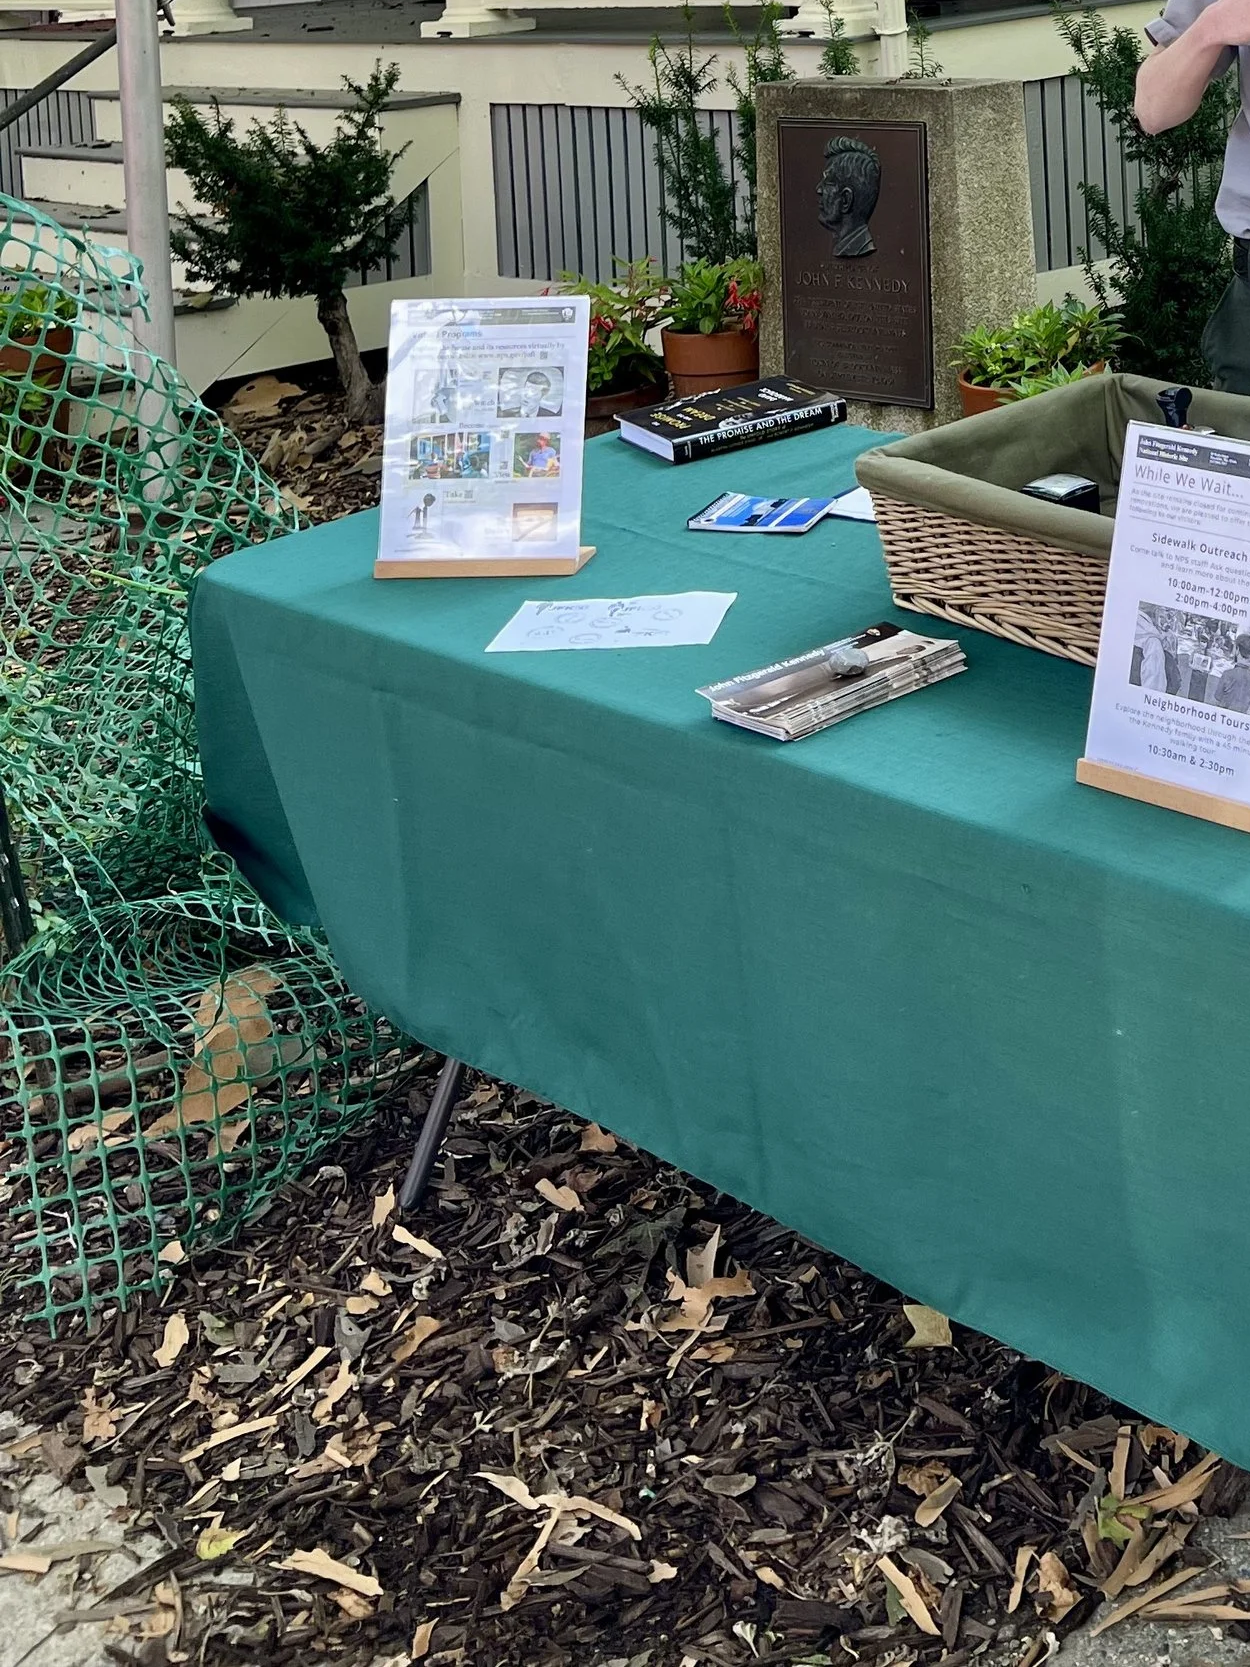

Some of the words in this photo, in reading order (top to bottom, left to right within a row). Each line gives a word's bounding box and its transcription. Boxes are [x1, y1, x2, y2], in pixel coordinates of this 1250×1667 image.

[796, 271, 829, 286] JOHN
[847, 276, 911, 293] KENNEDY
[698, 434, 714, 445] THE
[716, 424, 753, 440] PROMISE
[756, 419, 774, 429] AND
[775, 414, 791, 425] THE
[794, 407, 822, 420] DREAM
[1138, 447, 1158, 456] National
[1139, 438, 1151, 446] John
[1176, 444, 1198, 456] Kennedy
[1134, 463, 1170, 483] While
[1174, 472, 1195, 488] We
[1200, 477, 1244, 498] Wait...
[1193, 500, 1215, 510] closed
[1216, 504, 1226, 512] for
[1193, 509, 1219, 520] pleased
[1130, 544, 1150, 554] Come
[1151, 549, 1164, 558] talk
[1165, 552, 1172, 560] to
[1174, 555, 1189, 563] NPS
[1209, 562, 1223, 571] Ask
[1151, 532, 1196, 550] Sidewalk
[1199, 542, 1248, 562] Outreach
[1166, 576, 1249, 605] 10:00am-12:00pm
[1175, 565, 1193, 574] learn
[1194, 569, 1213, 578] more
[1215, 573, 1235, 583] about
[1237, 579, 1249, 587] the
[1174, 592, 1248, 619] 2:00pm-4:00pm
[710, 679, 733, 692] John
[735, 663, 782, 685] Fitzgerald
[782, 649, 825, 670] Kennedy
[1143, 694, 1217, 724] Neighborhood
[1220, 714, 1250, 731] Tours
[1142, 720, 1173, 735] Kennedy
[1198, 735, 1214, 745] with
[1222, 741, 1232, 750] 45
[1155, 713, 1205, 734] neighborhood
[1207, 727, 1237, 743] through
[1147, 743, 1187, 762] 10:30am
[1189, 755, 1196, 765] &
[1198, 758, 1234, 778] 2:30pm
